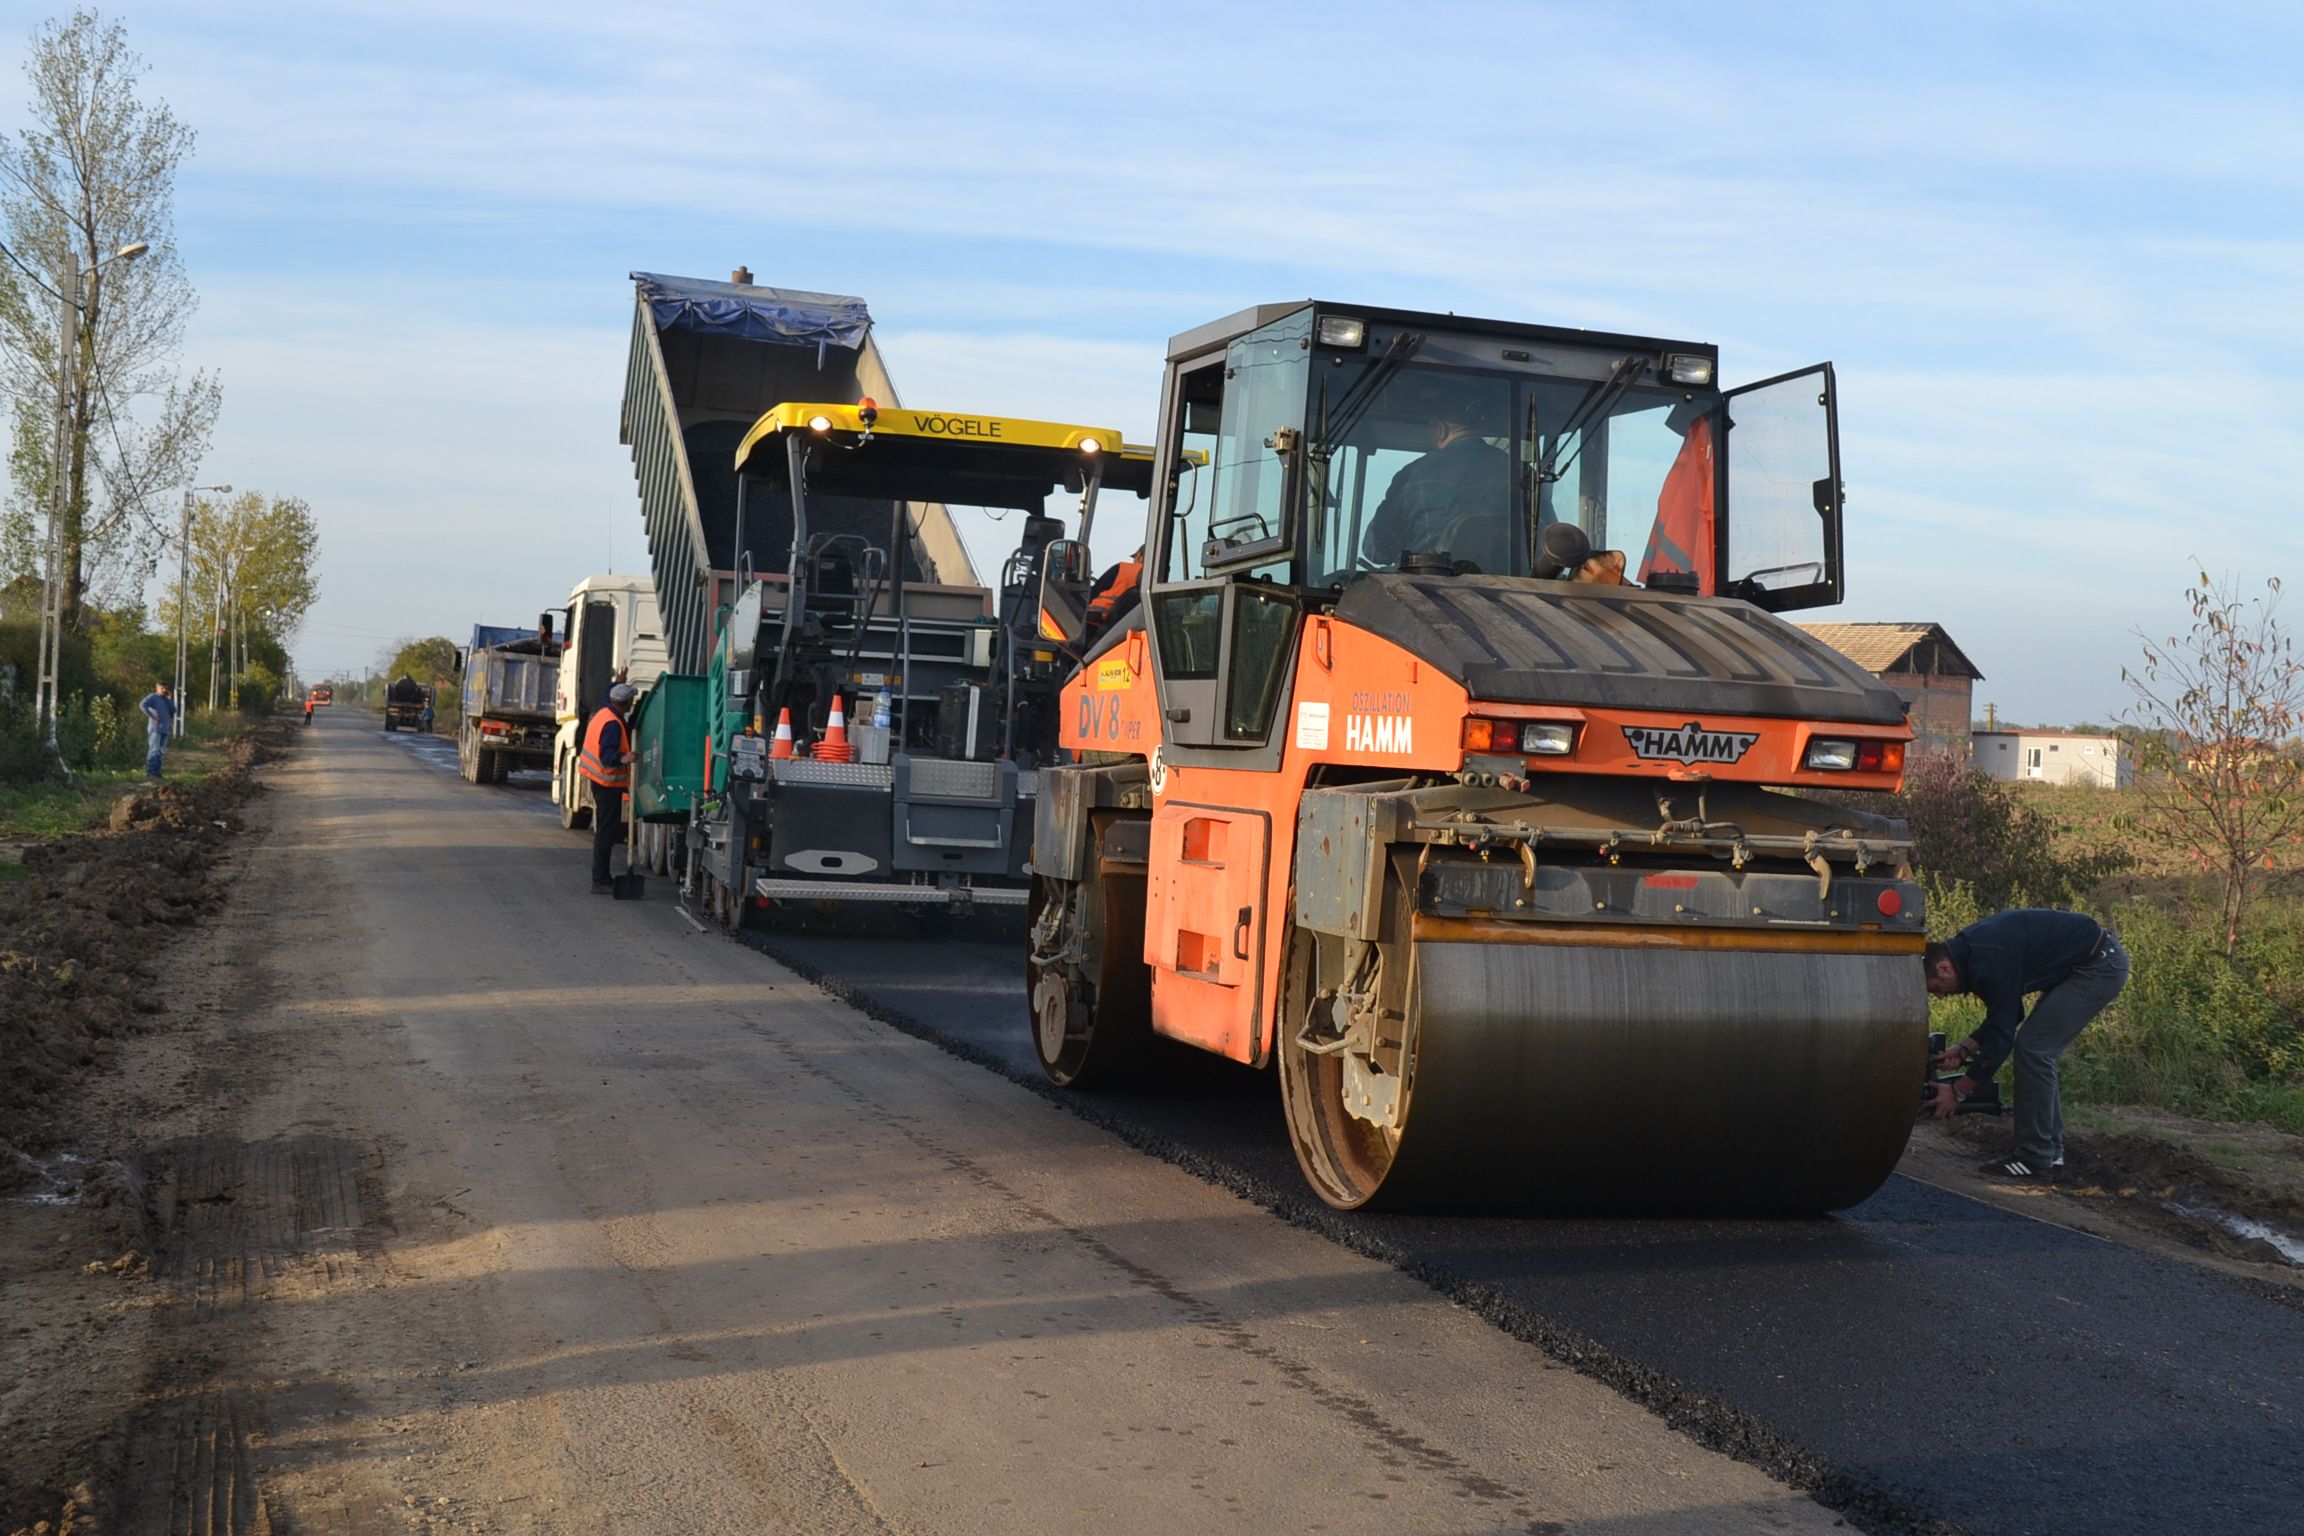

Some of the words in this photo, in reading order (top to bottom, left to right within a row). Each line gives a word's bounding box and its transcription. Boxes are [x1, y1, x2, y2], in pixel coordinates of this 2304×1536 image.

[914, 413, 1002, 438] VÖGELE
[1078, 694, 1105, 738] DV
[1109, 694, 1120, 740] 8
[1346, 714, 1412, 754] HAMM
[1643, 731, 1734, 758] HAMM
